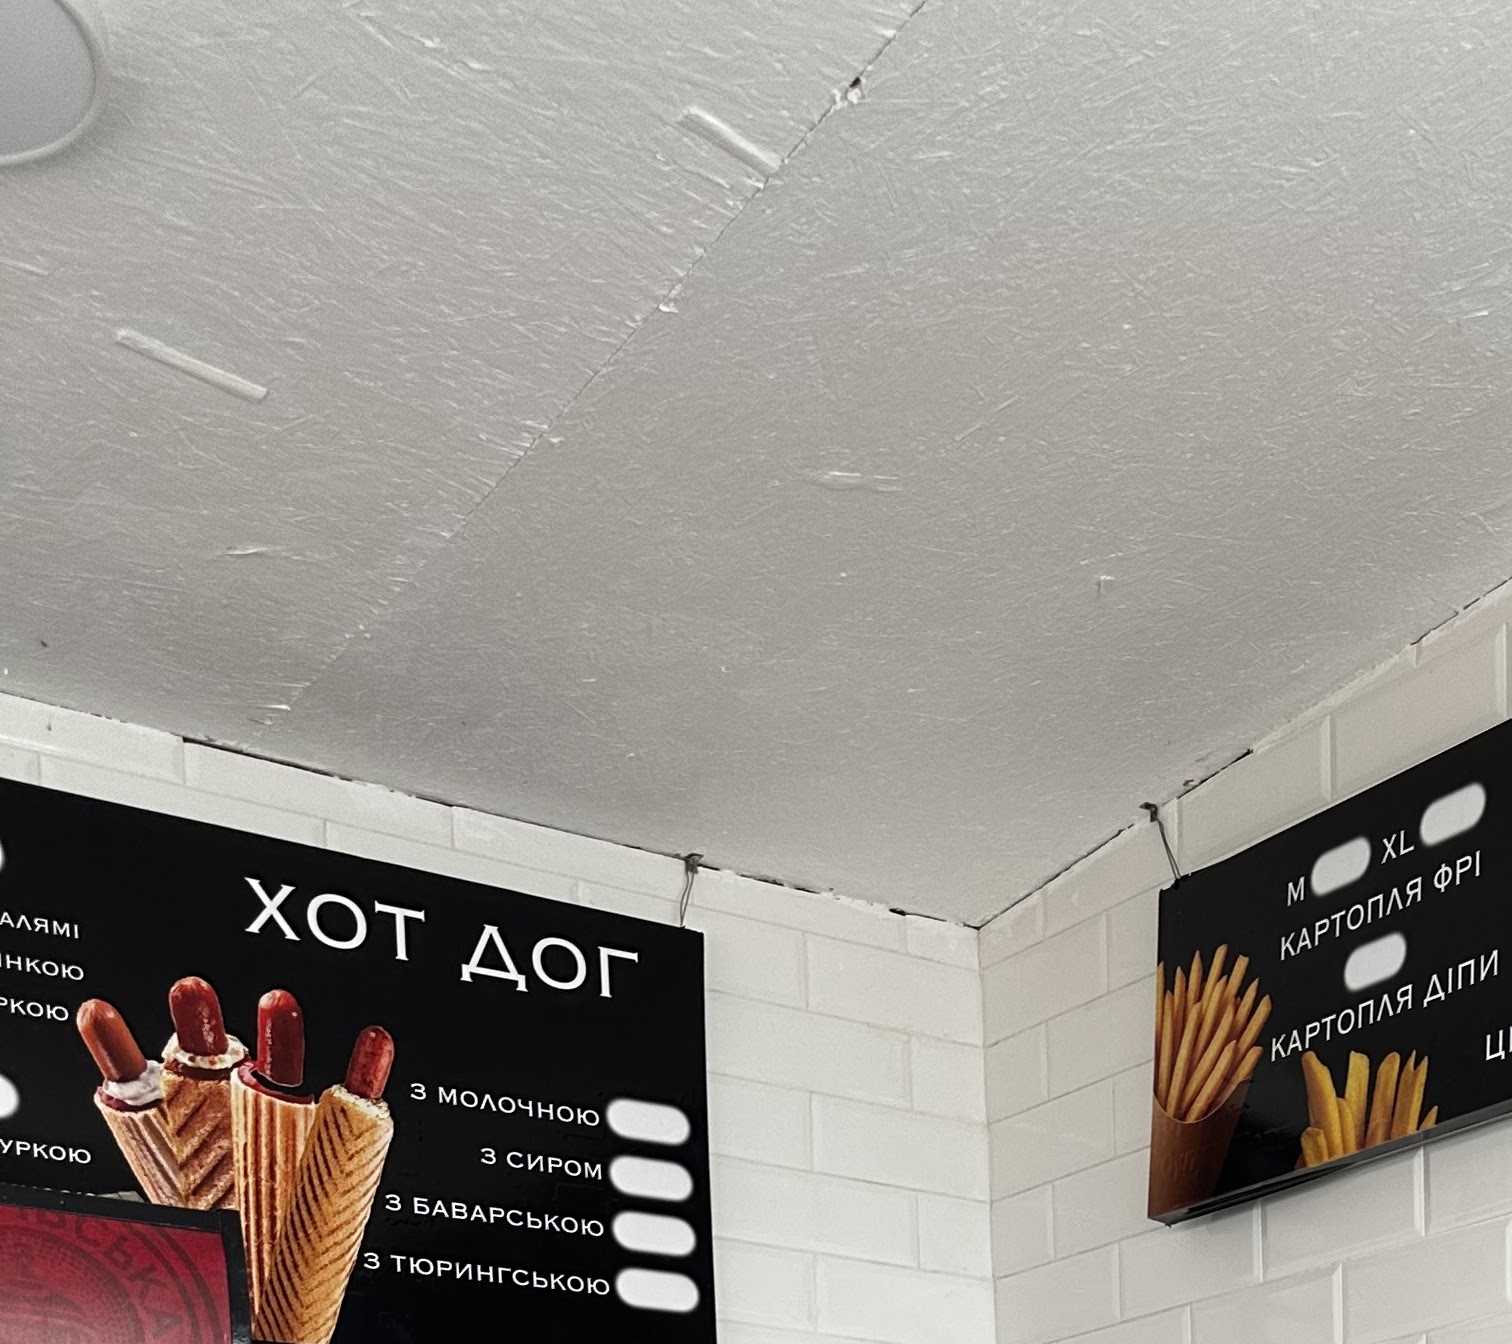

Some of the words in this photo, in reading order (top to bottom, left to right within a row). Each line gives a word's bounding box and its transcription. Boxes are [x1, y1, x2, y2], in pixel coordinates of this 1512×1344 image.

[1286, 876, 1306, 907] M
[1380, 829, 1415, 865] XL
[1279, 876, 1422, 961] КАРТОПЛЯ
[1433, 850, 1482, 894] ФРІ
[244, 877, 425, 961] ХОТ
[460, 924, 639, 998] ДОГ
[1270, 982, 1413, 1063] КАРТОПЛЯ
[1423, 947, 1500, 1007] ДІПИ
[437, 1085, 600, 1127] МОЛОЧНОЮ
[506, 1150, 603, 1181] СИРОМ
[414, 1196, 604, 1238] БАВАРСЬКОЮ
[390, 1254, 610, 1296] ТЮРИНГСЬКОЮ
